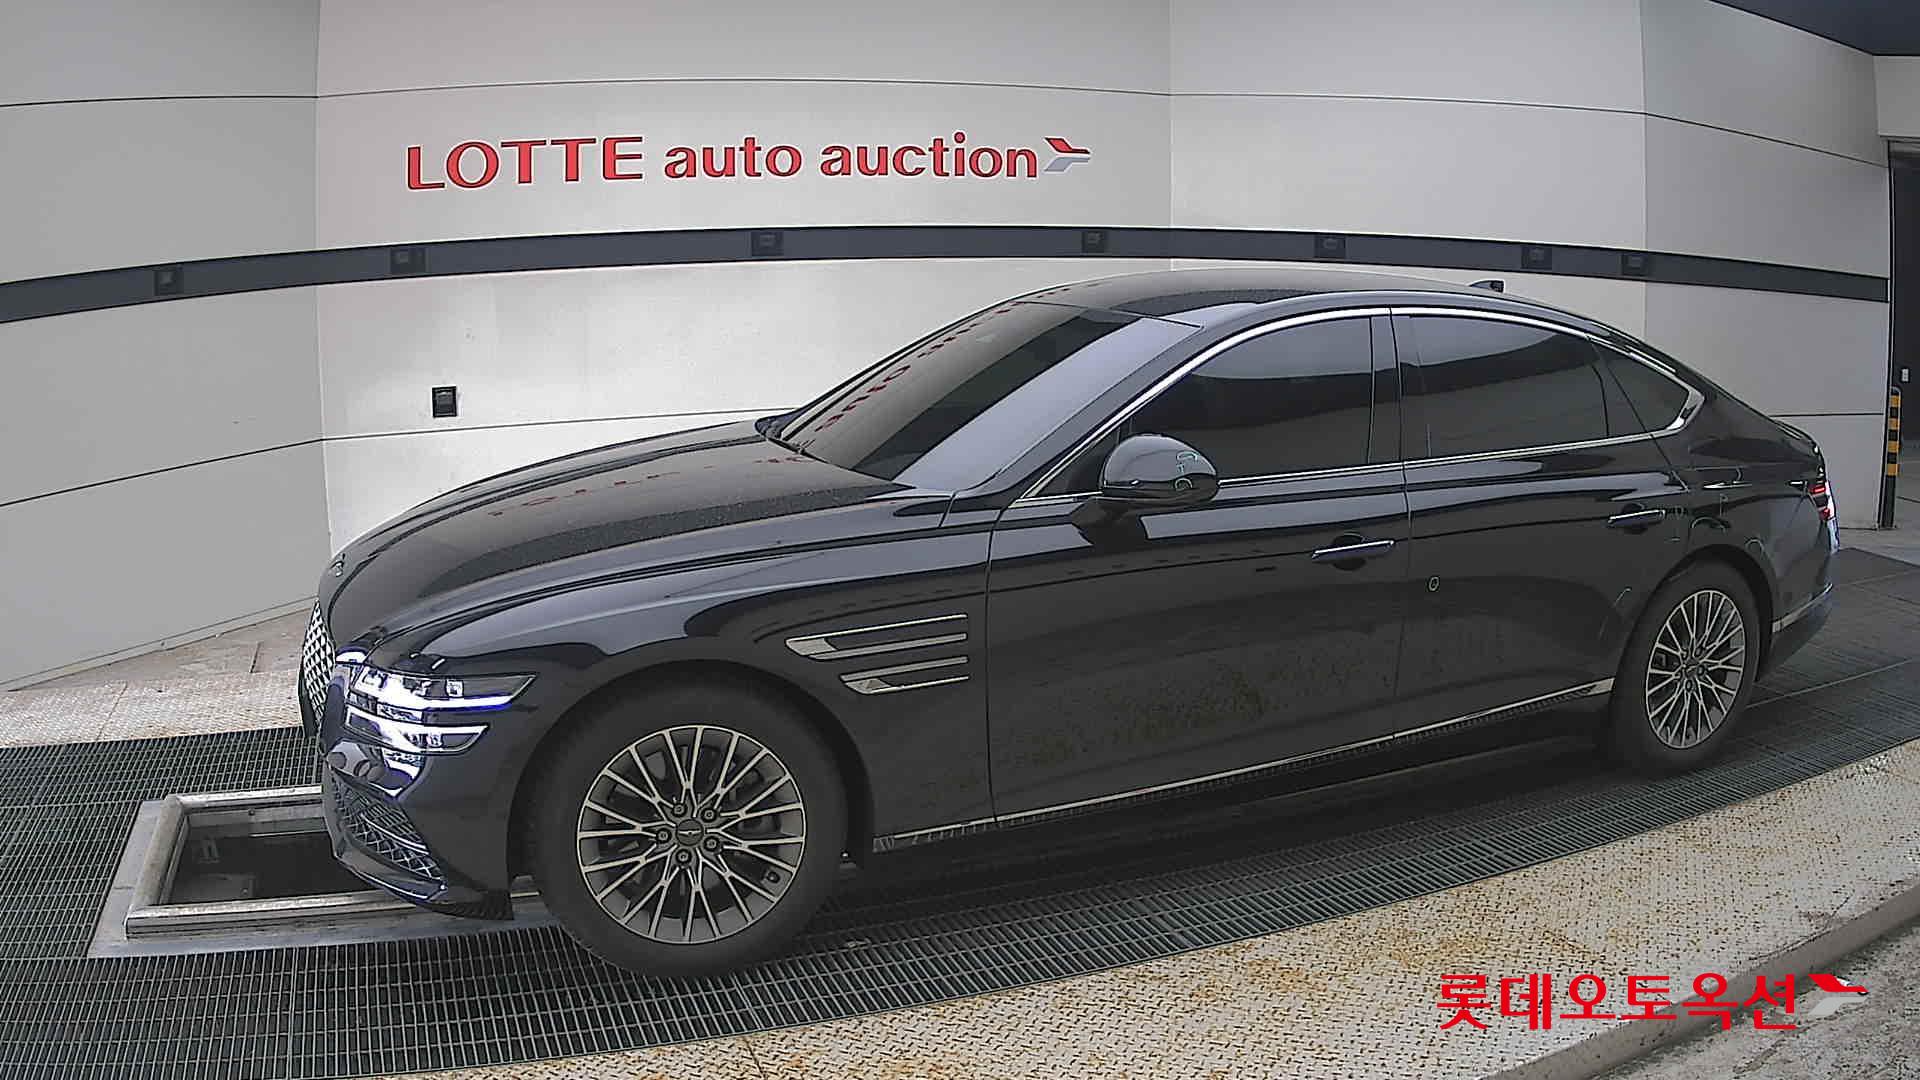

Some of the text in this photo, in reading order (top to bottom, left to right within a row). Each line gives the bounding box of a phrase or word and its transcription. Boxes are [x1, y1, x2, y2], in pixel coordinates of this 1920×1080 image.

[406, 131, 1038, 190] LOTTE auto auction
